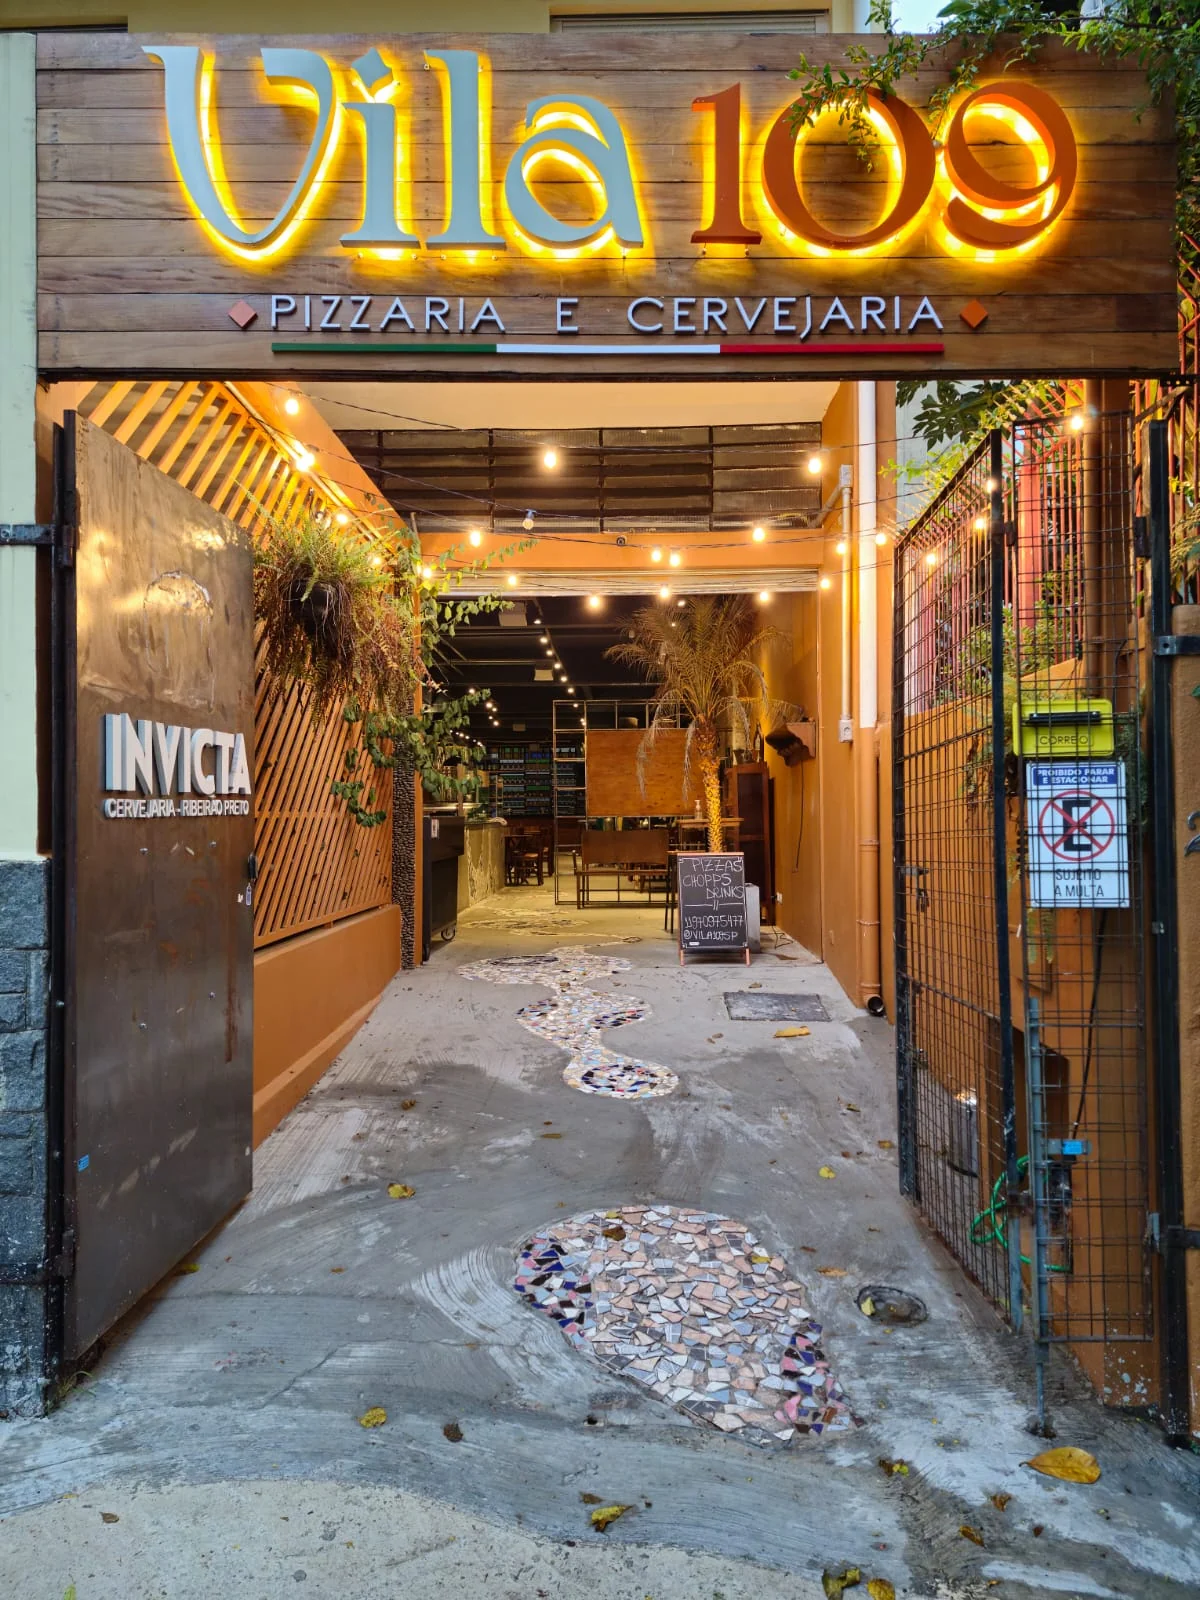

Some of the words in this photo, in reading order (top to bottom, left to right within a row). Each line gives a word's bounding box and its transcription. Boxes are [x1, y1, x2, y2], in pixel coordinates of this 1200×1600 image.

[141, 45, 644, 250] Vila
[690, 80, 1079, 250] 109
[270, 294, 506, 333] PIZZARIA
[556, 298, 580, 333] E
[626, 296, 945, 339] CERVEJARIA
[1039, 735, 1089, 746] CORREO
[105, 713, 251, 796] INVICTA
[1038, 769, 1082, 777] PROIBIDO
[1084, 768, 1115, 776] PARAR
[104, 798, 176, 818] CERVEJARIA
[223, 800, 250, 816] PRETO
[692, 859, 743, 872] PIZZAS
[682, 873, 732, 887] CHOPPS
[1055, 868, 1102, 881] SUJEITO
[706, 886, 745, 900] DRINKS
[1054, 885, 1062, 897] A
